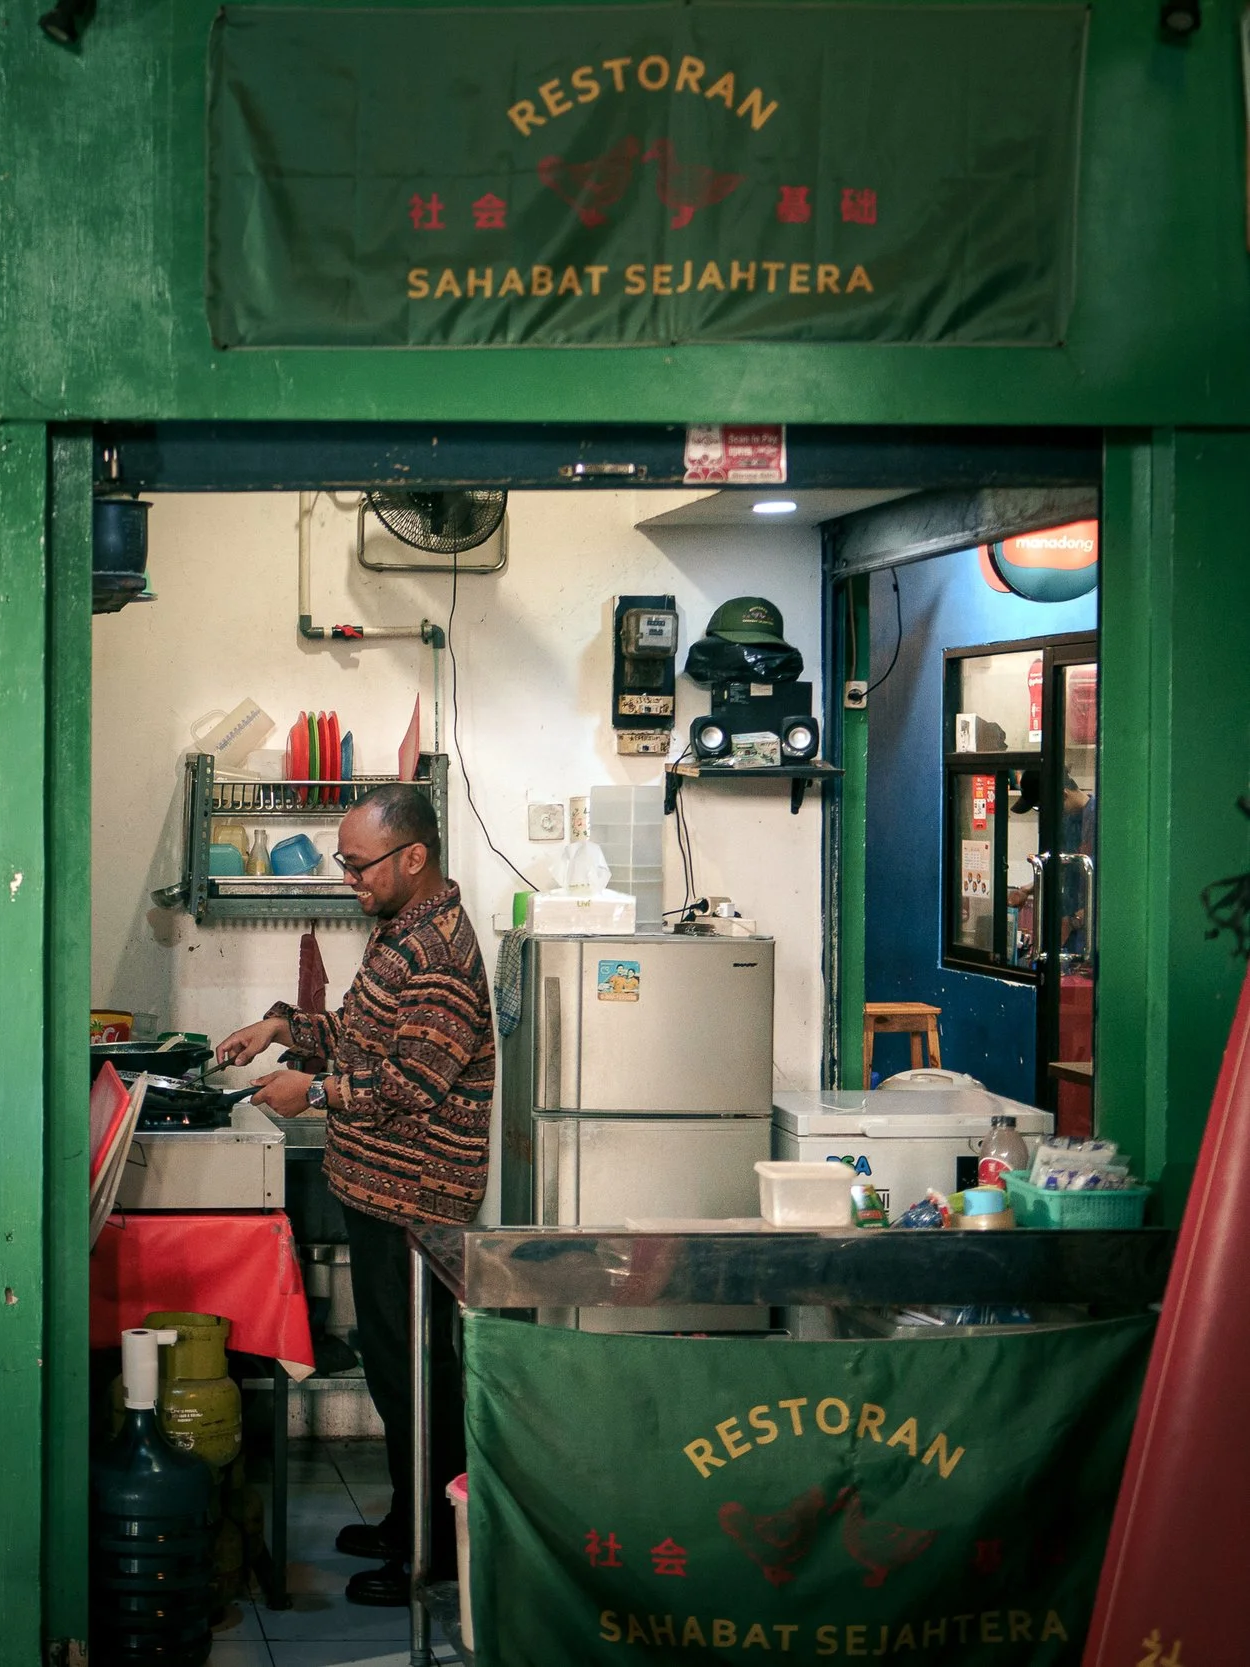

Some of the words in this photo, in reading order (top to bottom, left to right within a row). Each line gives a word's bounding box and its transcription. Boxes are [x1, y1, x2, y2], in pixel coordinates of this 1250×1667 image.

[507, 54, 779, 136] RESTORAN
[406, 264, 609, 299] SAHABAT
[623, 260, 875, 296] SEJAHTERA
[1015, 535, 1094, 552] manadong
[682, 1397, 966, 1480] RESTORAN
[599, 1609, 799, 1656] SAHABAT
[815, 1609, 1070, 1657] SEJAHTERA
